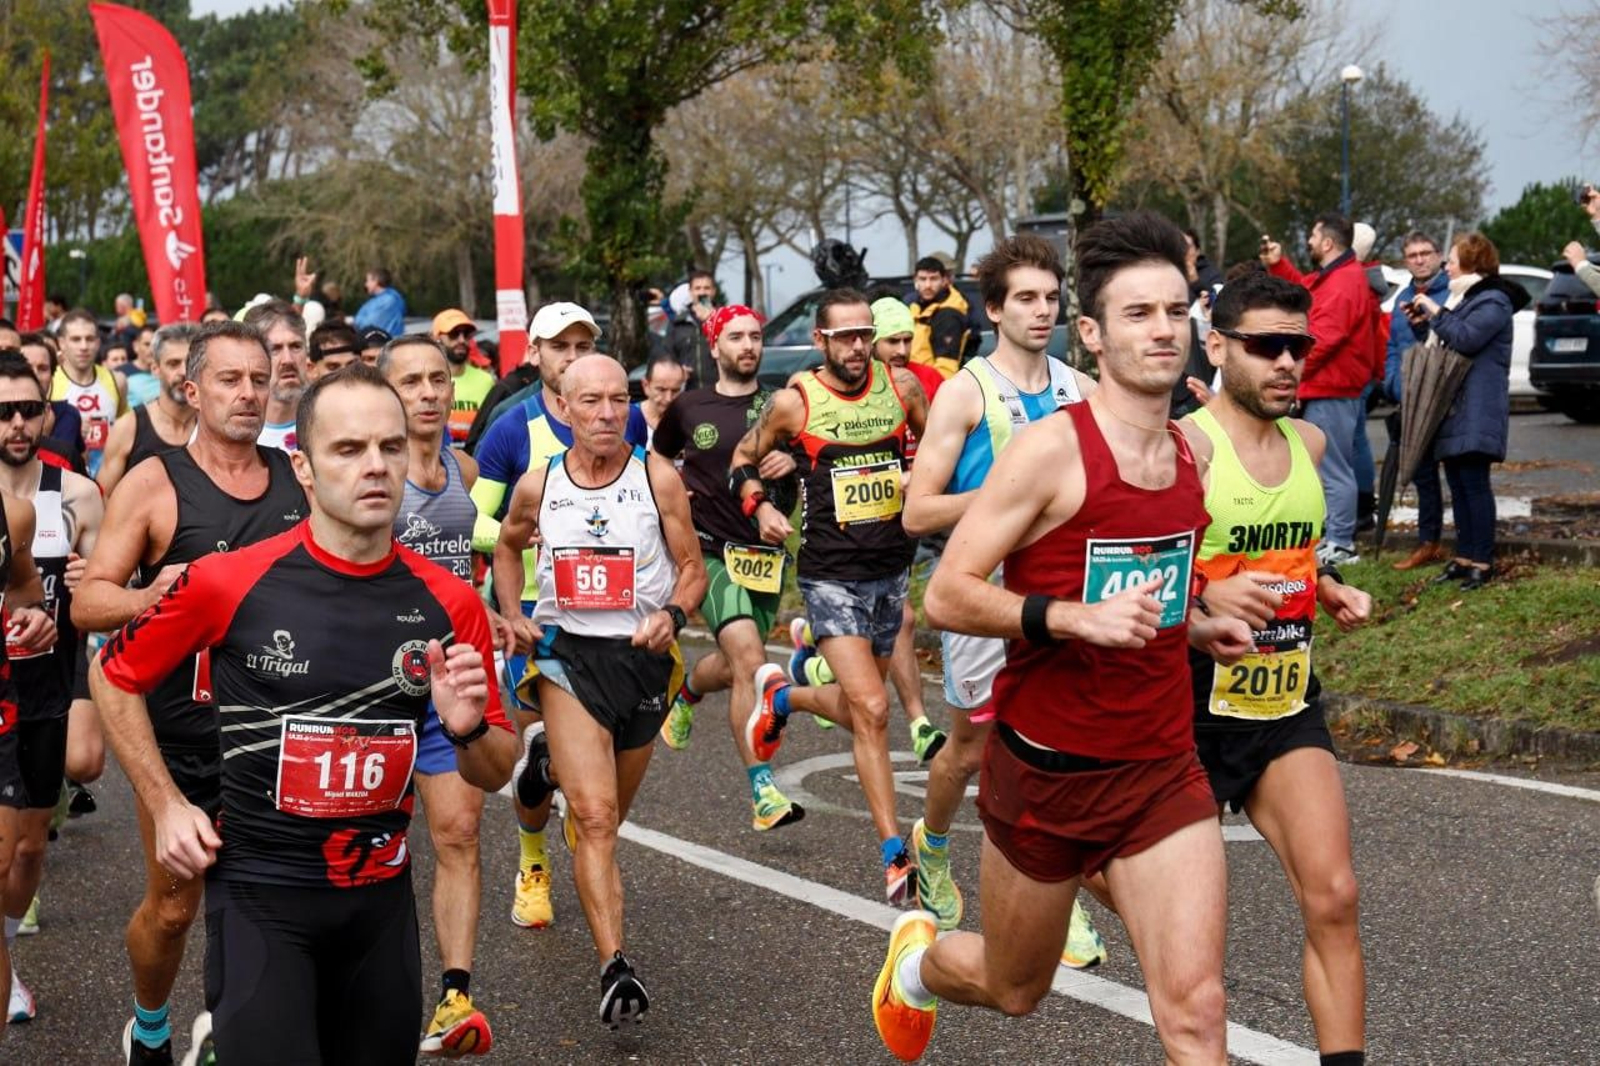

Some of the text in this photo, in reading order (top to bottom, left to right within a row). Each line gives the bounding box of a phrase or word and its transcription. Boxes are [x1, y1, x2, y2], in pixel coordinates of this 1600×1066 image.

[844, 479, 895, 505] 2006
[1228, 521, 1313, 553] 3NORTH
[576, 565, 607, 591] 56
[733, 557, 774, 578] 2002
[246, 654, 257, 669] El
[260, 655, 310, 677] Trigal
[1228, 662, 1300, 695] 2016
[314, 751, 386, 790] 116
